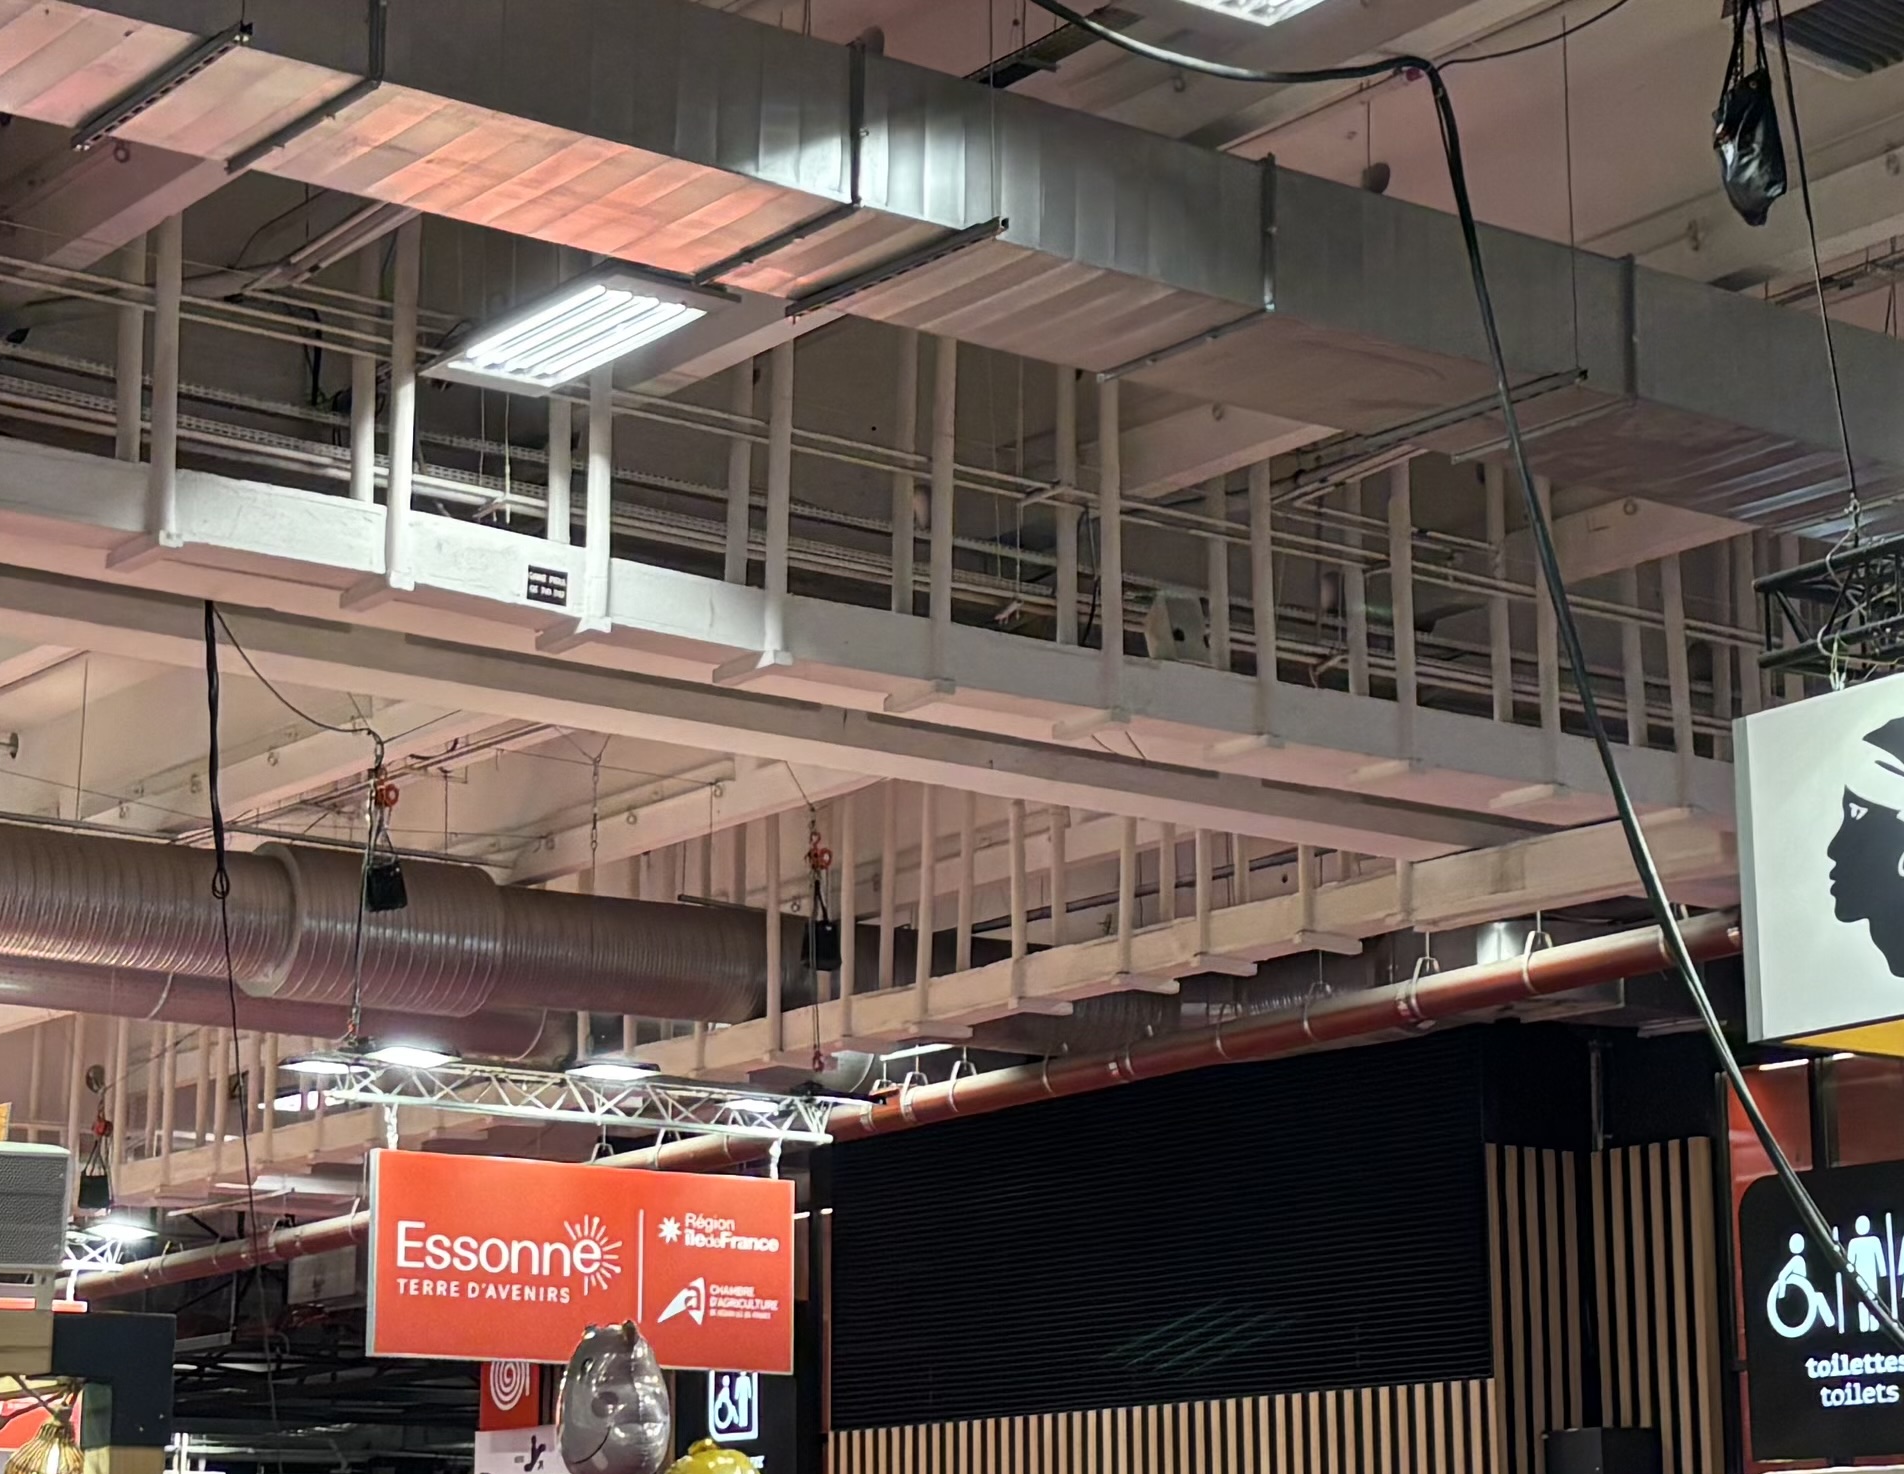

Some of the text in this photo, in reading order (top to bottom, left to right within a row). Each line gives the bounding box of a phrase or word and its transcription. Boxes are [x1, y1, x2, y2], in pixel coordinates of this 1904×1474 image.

[685, 1212, 735, 1233] Région
[396, 1219, 603, 1277] Essonne
[397, 1277, 571, 1304] TERRE D'AVENIRS
[1820, 1381, 1900, 1407] toilets
